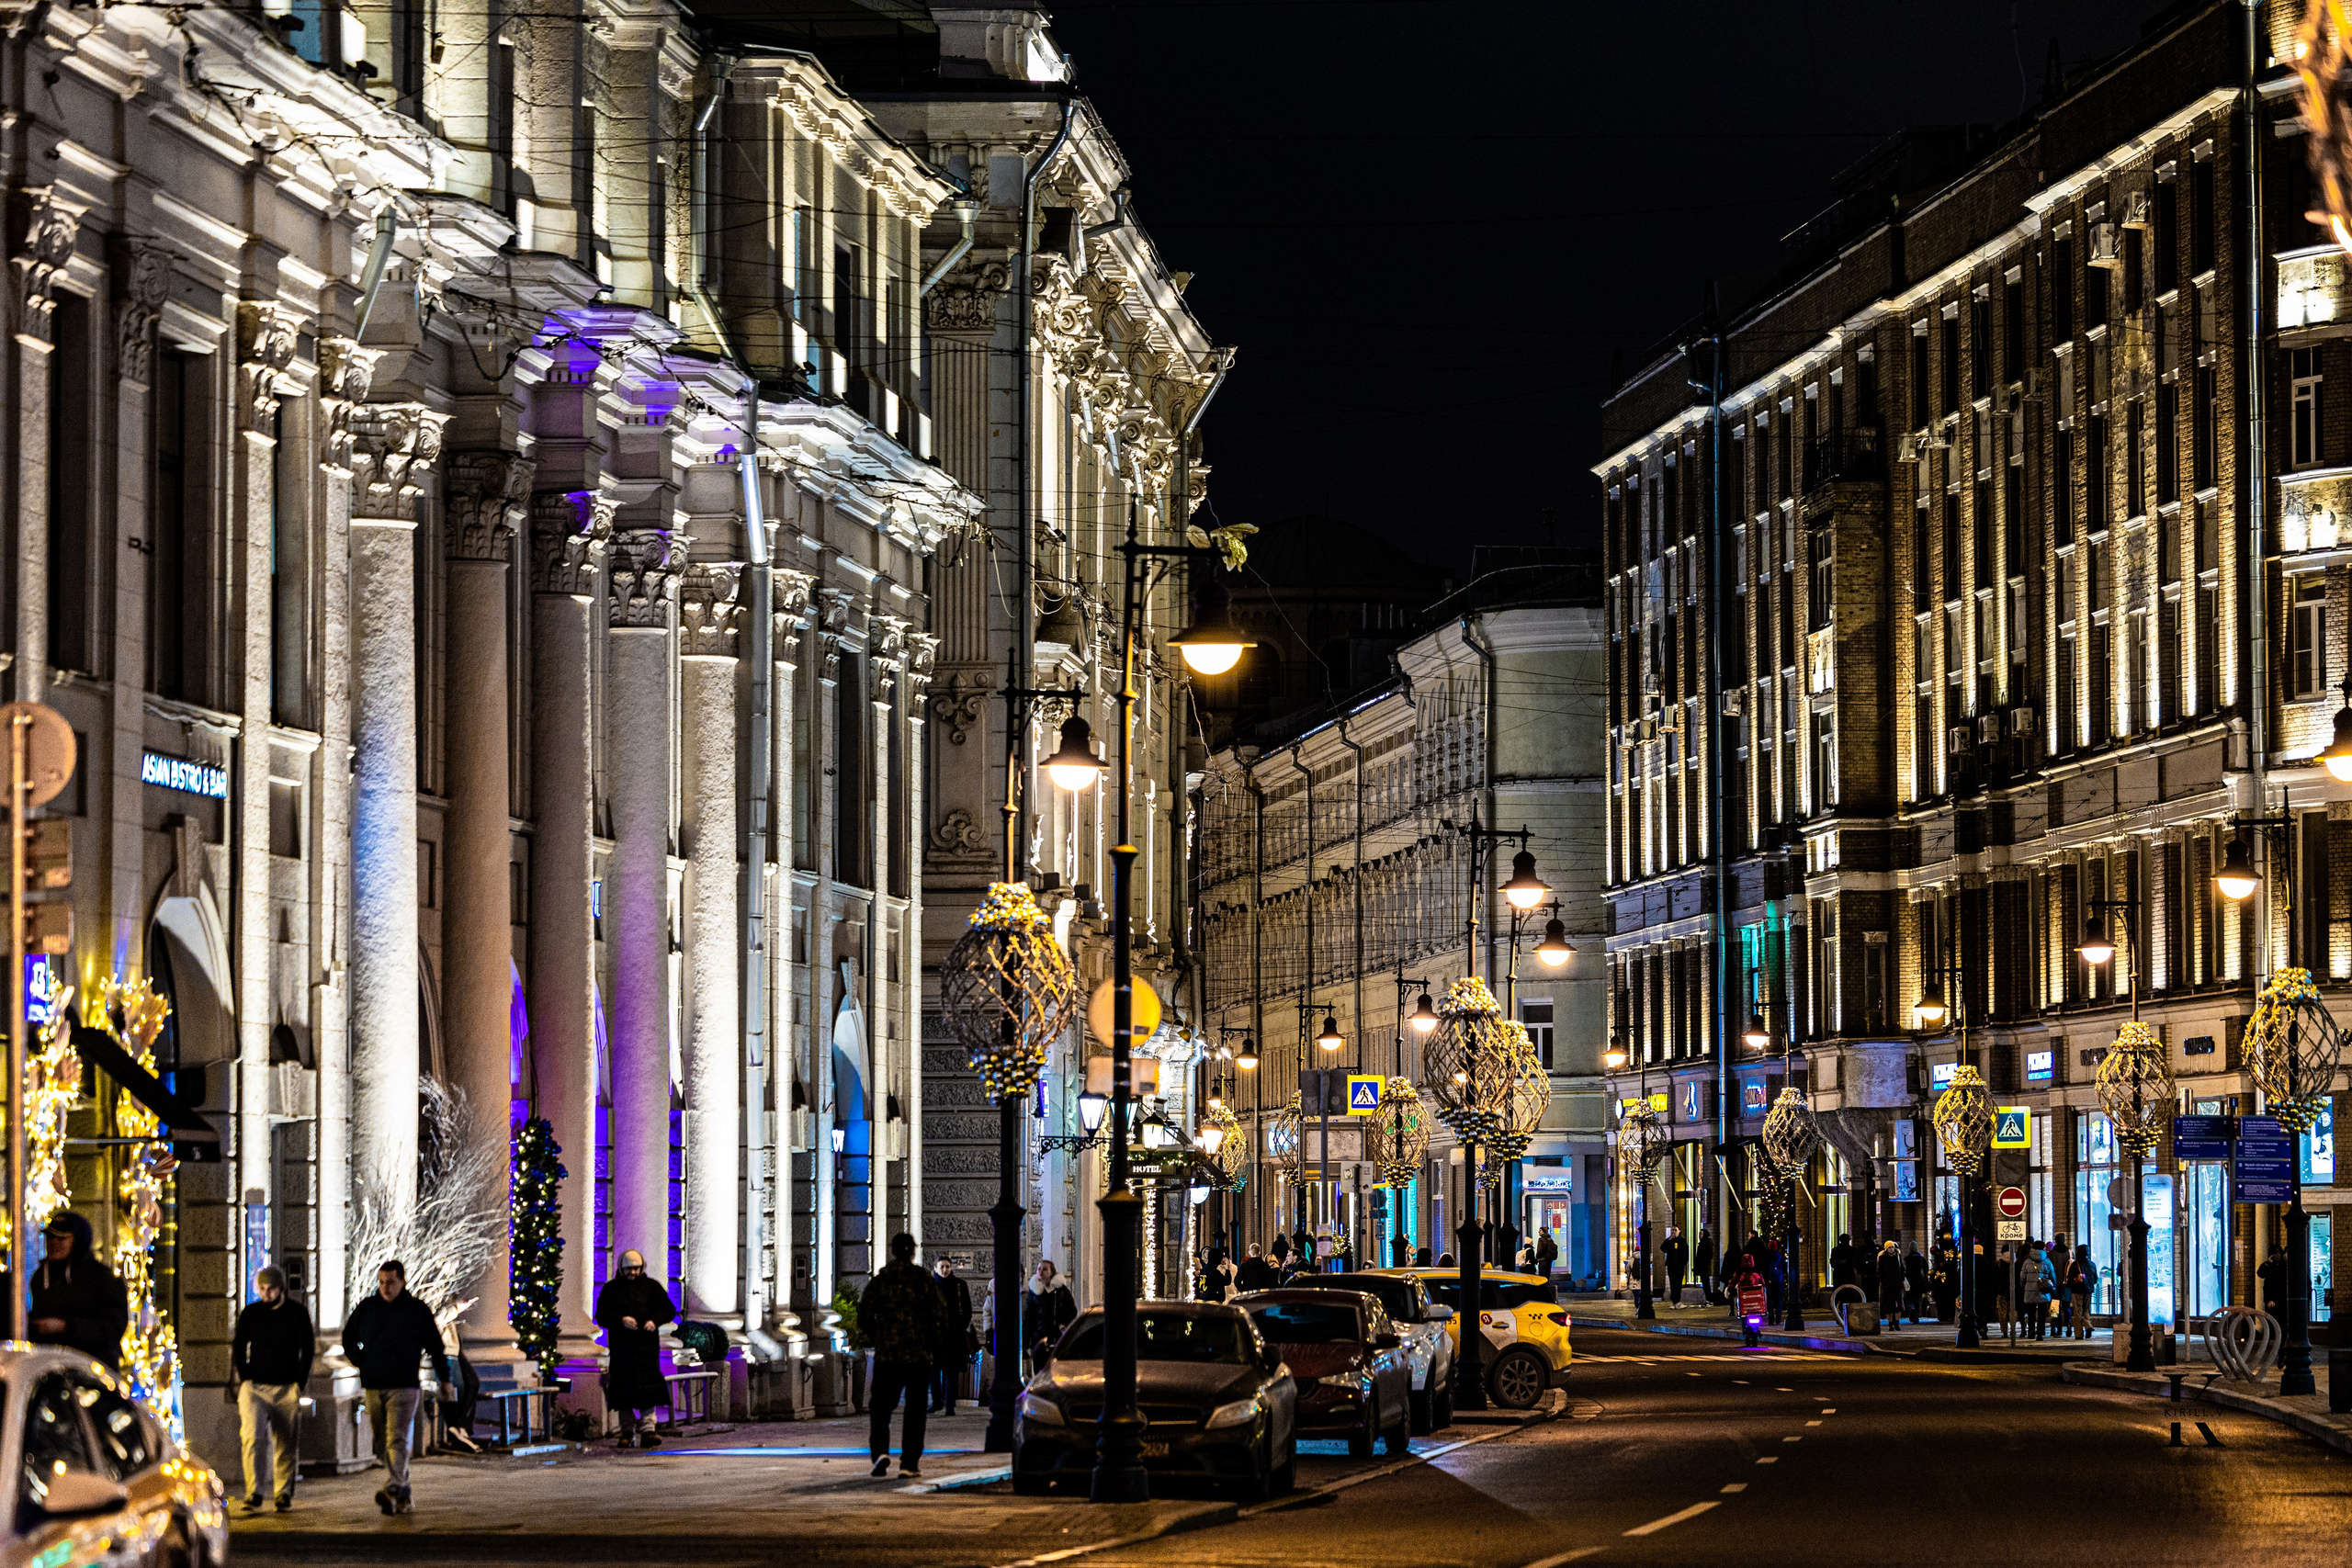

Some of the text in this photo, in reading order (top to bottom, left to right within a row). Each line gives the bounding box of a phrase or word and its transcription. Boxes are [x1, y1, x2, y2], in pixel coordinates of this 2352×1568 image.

[141, 753, 171, 788] ASIAN
[209, 769, 228, 799] BAR
[1132, 1165, 1162, 1173] HOTEL
